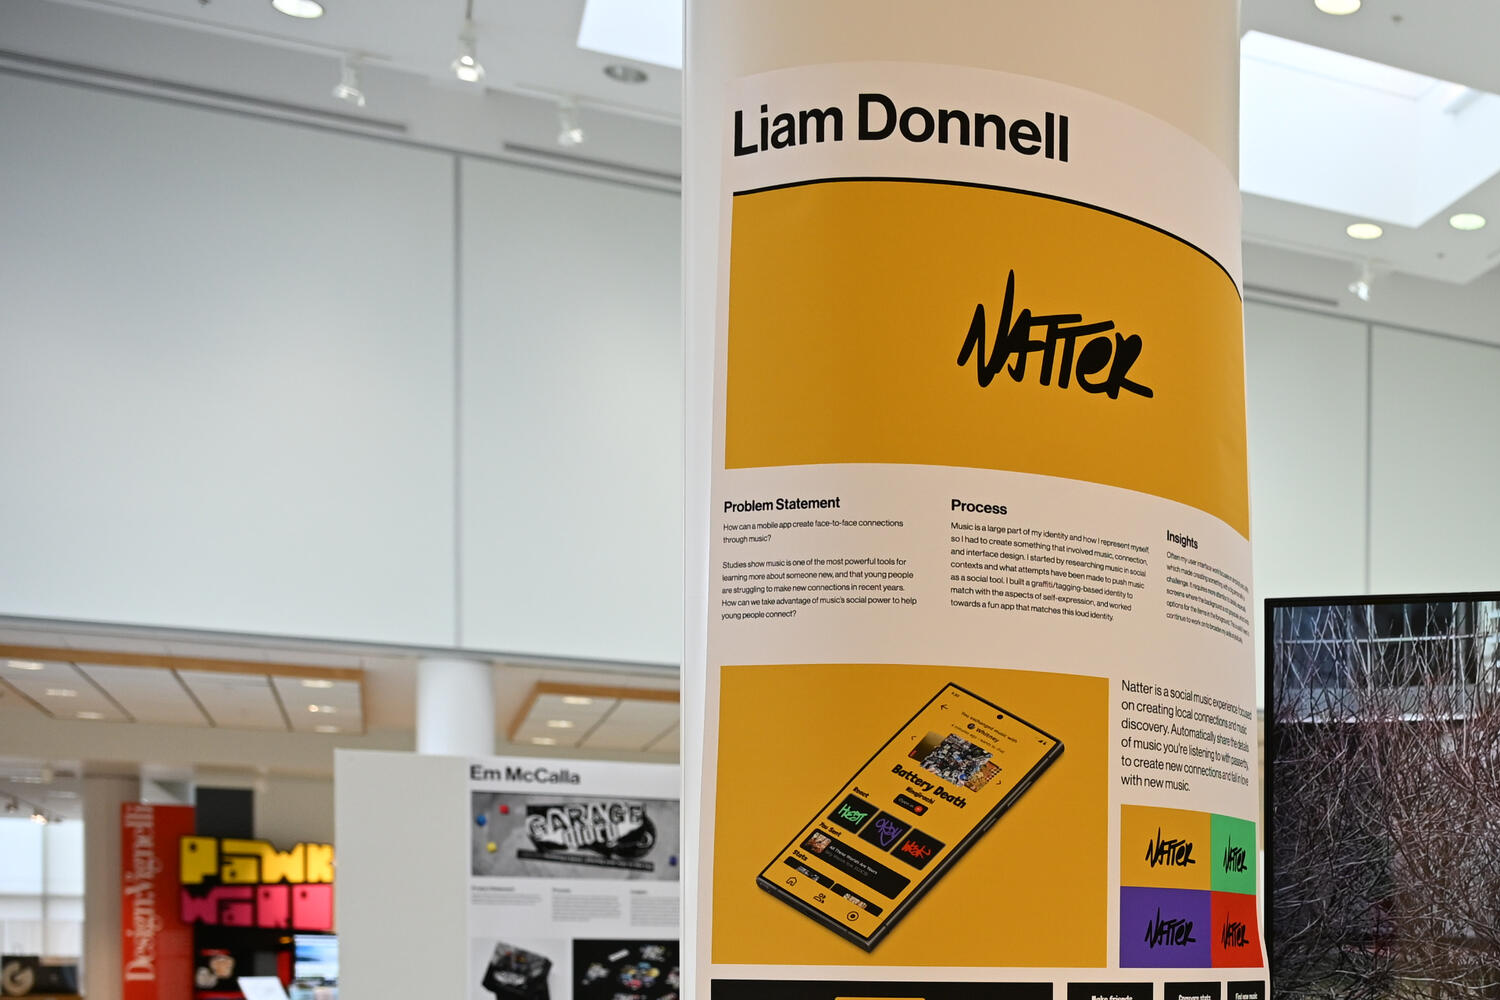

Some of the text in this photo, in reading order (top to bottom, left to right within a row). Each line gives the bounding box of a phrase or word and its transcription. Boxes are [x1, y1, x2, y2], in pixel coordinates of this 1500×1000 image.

[733, 93, 1070, 163] Liam Donnell
[723, 496, 841, 513] Problem Statement
[951, 499, 1007, 515] Process
[723, 523, 738, 531] How
[757, 521, 778, 530] mobile
[792, 520, 814, 528] create
[815, 519, 857, 528] face-to-face
[858, 519, 904, 527] connections
[723, 534, 772, 544] through music?
[1166, 530, 1199, 549] Insights
[722, 561, 747, 569] Studies
[806, 558, 813, 566] of
[814, 558, 825, 566] the
[826, 558, 844, 566] most
[844, 557, 876, 566] powerful
[877, 558, 895, 566] tools
[896, 558, 906, 566] for
[1122, 680, 1212, 706] Natter is a social music
[1121, 701, 1228, 728] on creating local connections
[1121, 718, 1216, 744] discovery. Automatically
[1121, 736, 1214, 762] of music you're listening
[469, 765, 581, 785] Em McCalla
[1121, 755, 1222, 780] to create new connections
[891, 763, 967, 809] Battery Death
[1121, 774, 1190, 792] with new music.
[792, 849, 808, 862] Stats
